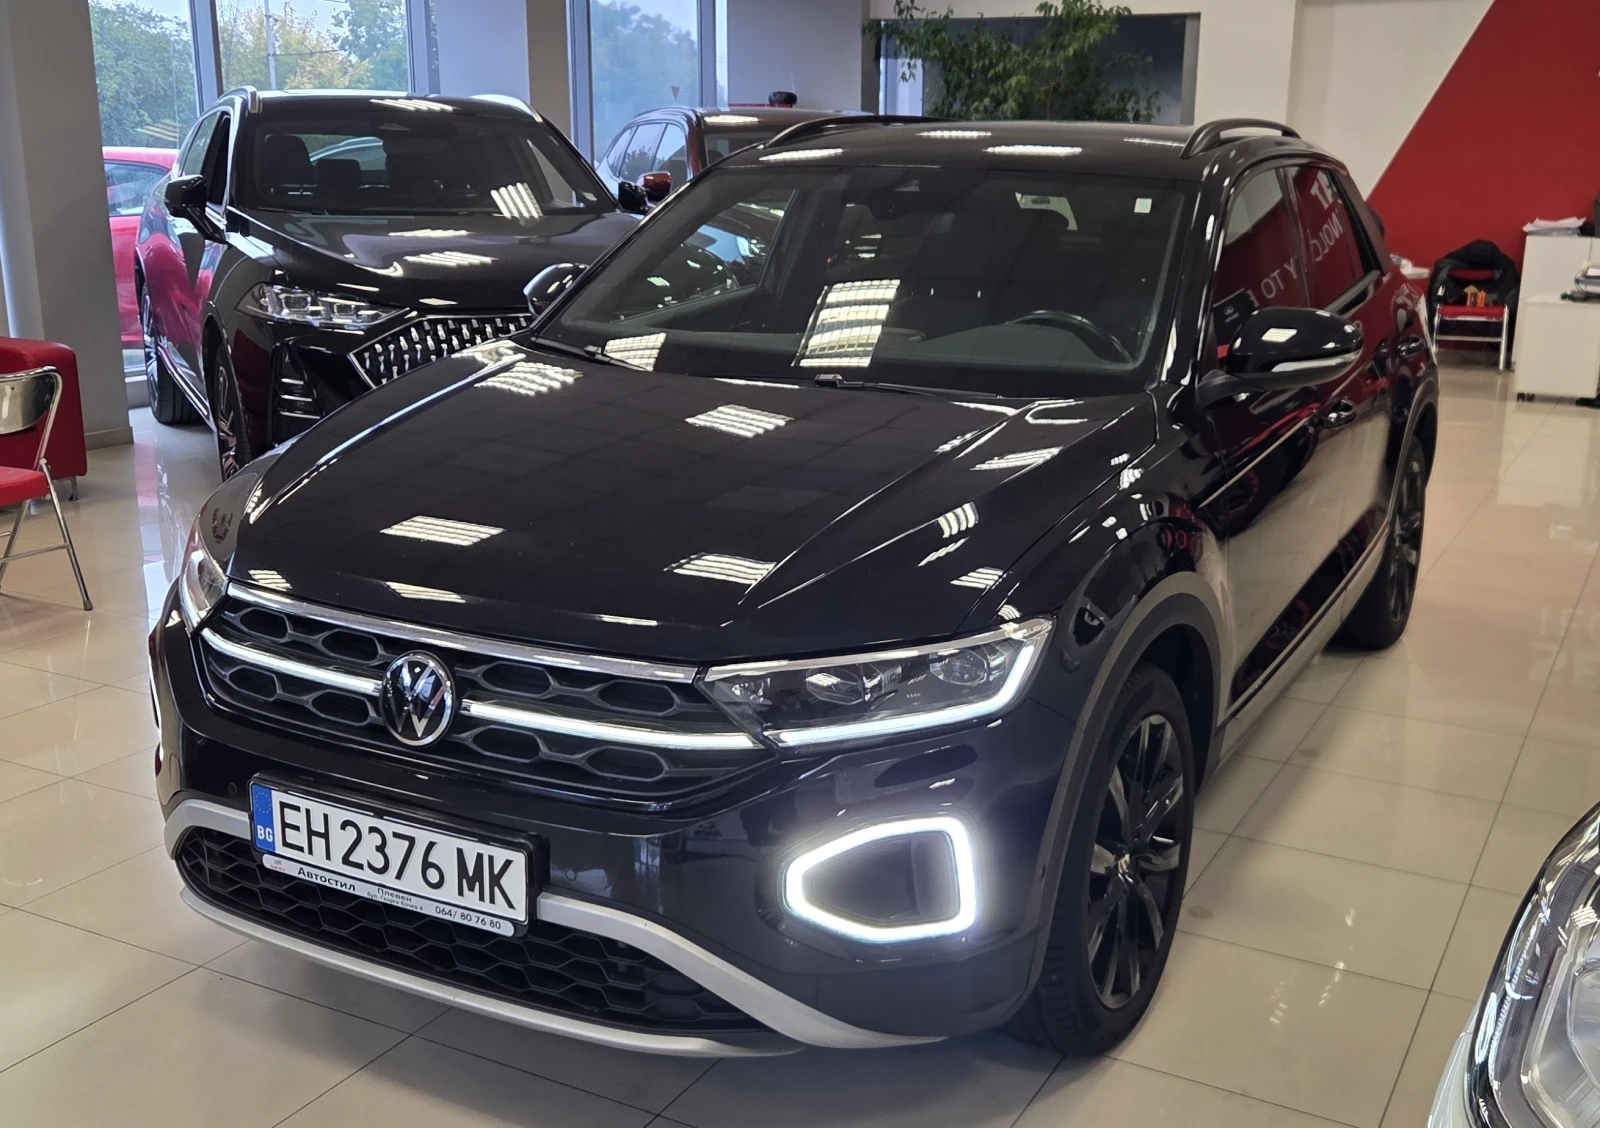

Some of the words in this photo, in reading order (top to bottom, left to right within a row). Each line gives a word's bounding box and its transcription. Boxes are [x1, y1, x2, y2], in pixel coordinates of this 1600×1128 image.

[256, 824, 273, 843] BG
[339, 819, 446, 890] 2376
[456, 847, 517, 910] MK
[460, 912, 472, 922] 80
[474, 916, 487, 926] 76
[489, 919, 502, 930] 80
